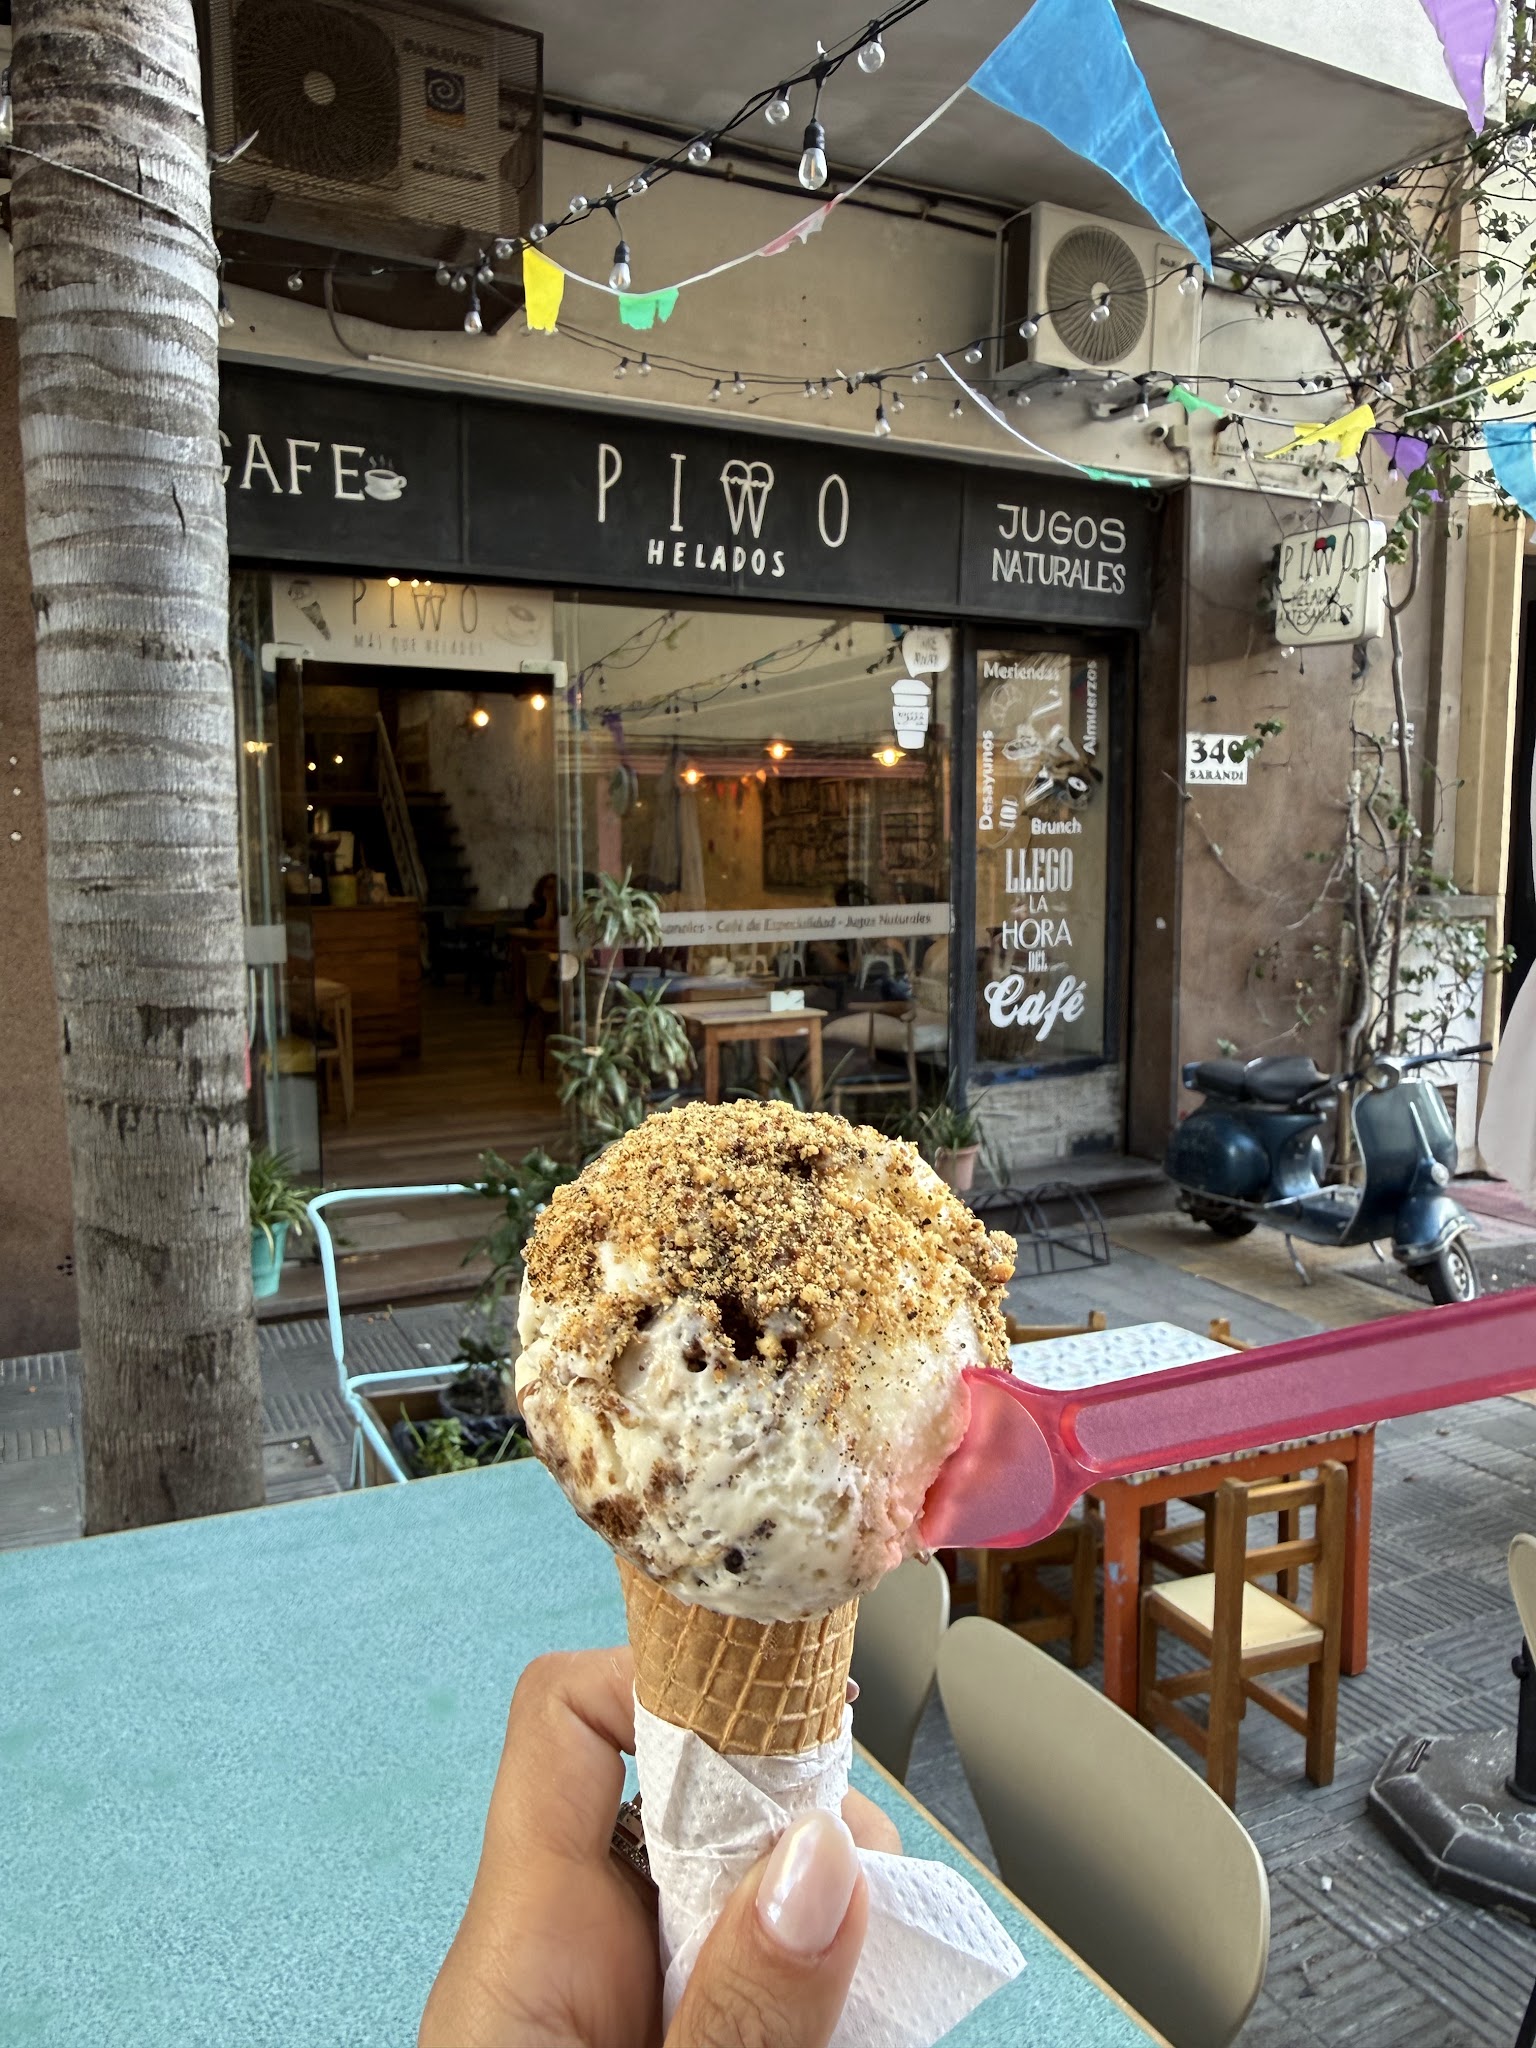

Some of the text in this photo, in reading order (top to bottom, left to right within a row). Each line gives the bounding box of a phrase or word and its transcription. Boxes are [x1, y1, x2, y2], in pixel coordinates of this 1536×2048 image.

[598, 443, 849, 548] PIWO
[997, 503, 1127, 553] JUGOS
[648, 539, 785, 577] HELADOS
[991, 548, 1127, 595] NATURALES
[983, 661, 1060, 682] Meriendas
[1083, 659, 1098, 756] Almuerzos
[979, 729, 996, 831] Desayunos
[1189, 769, 1244, 781] SARANDI
[1031, 817, 1082, 835] Brunch
[1005, 847, 1074, 893] LLEGO
[1029, 894, 1048, 914] LA
[1002, 918, 1073, 950] HORA
[1028, 950, 1048, 972] DEL
[983, 973, 1087, 1042] Café
